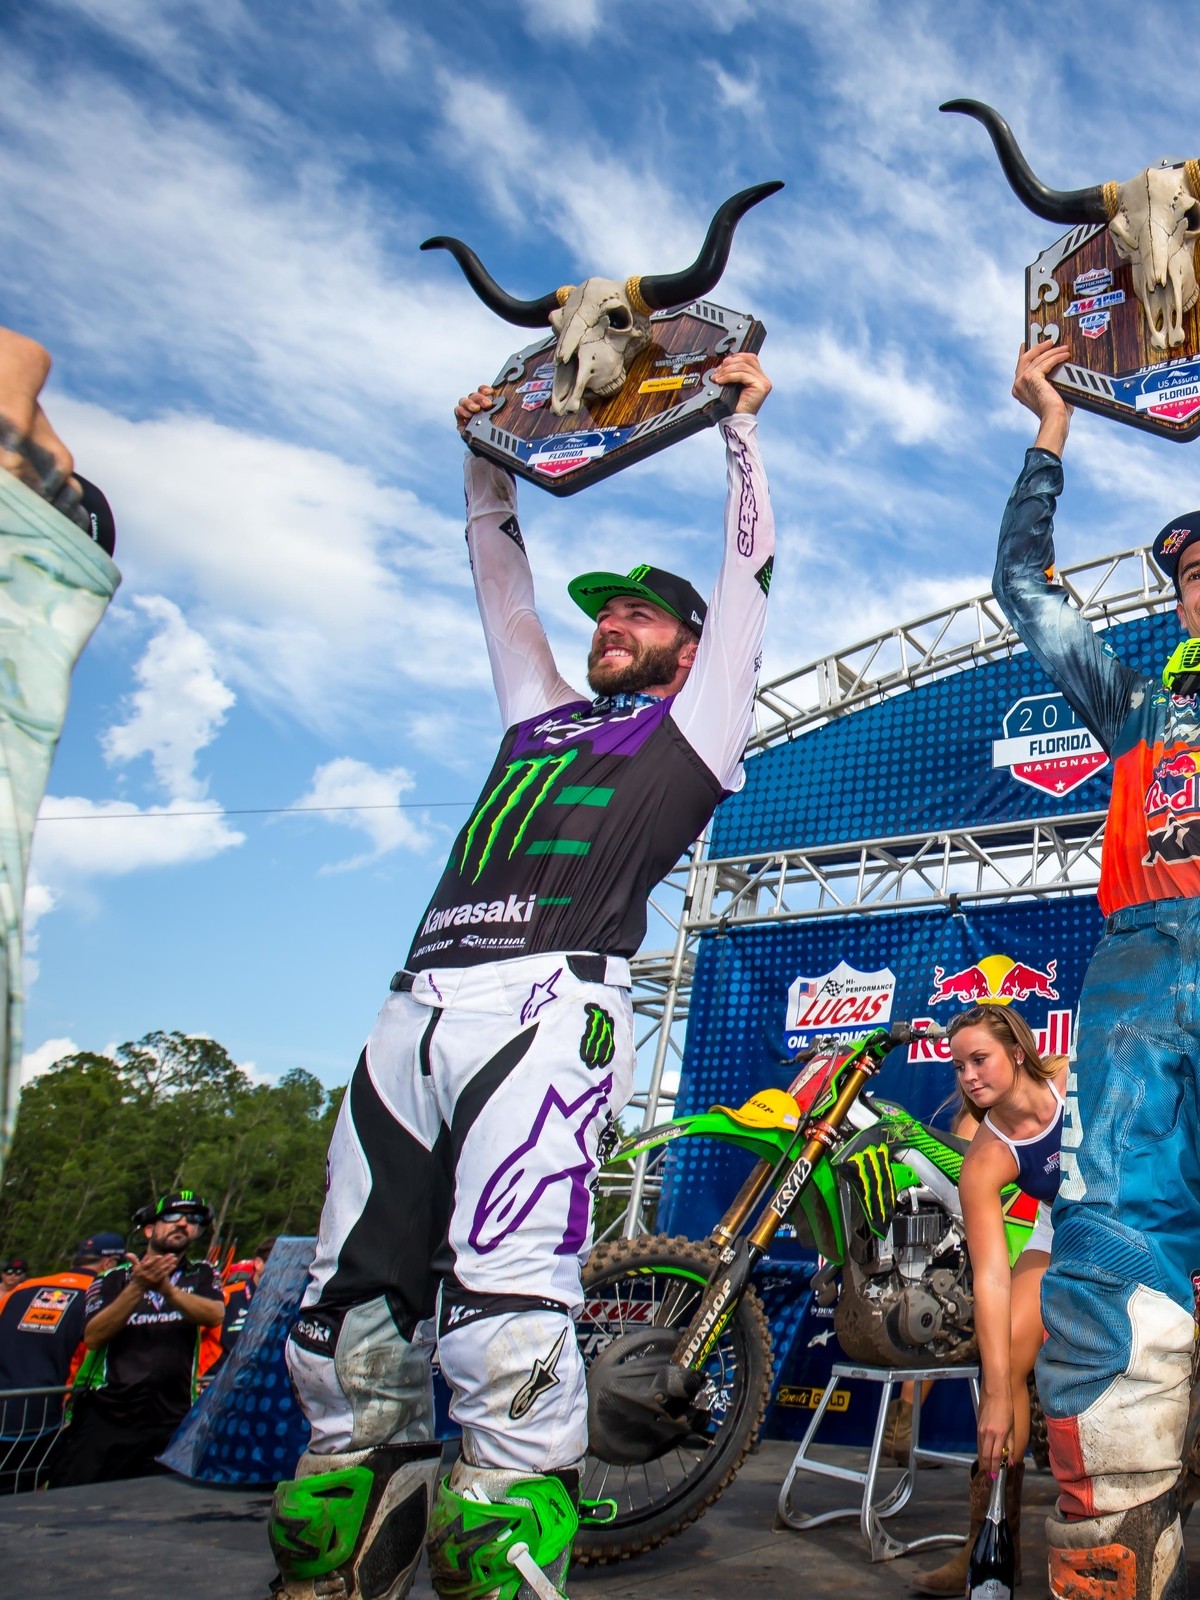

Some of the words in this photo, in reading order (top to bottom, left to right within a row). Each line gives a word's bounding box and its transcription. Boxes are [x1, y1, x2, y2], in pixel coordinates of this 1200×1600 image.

[1067, 297, 1102, 315] AMA
[1102, 292, 1123, 301] PRO
[1135, 362, 1168, 375] JUNE
[1157, 380, 1170, 389] US
[1171, 375, 1199, 385] Assure
[1159, 386, 1199, 402] FLORIDA
[547, 449, 584, 461] FLORIDA
[1018, 704, 1075, 732] 201
[1029, 733, 1092, 756] FLORIDA
[1023, 756, 1099, 773] NATIONAL
[420, 893, 538, 938] Kawasaki
[415, 939, 454, 958] DUNLOP
[845, 983, 894, 993] PERFORMANCE
[796, 993, 890, 1028] LUCAS
[787, 1035, 810, 1049] OIL
[907, 1016, 952, 1063] Re
[680, 1277, 732, 1369] DUNLOP
[812, 1393, 845, 1406] GLD
